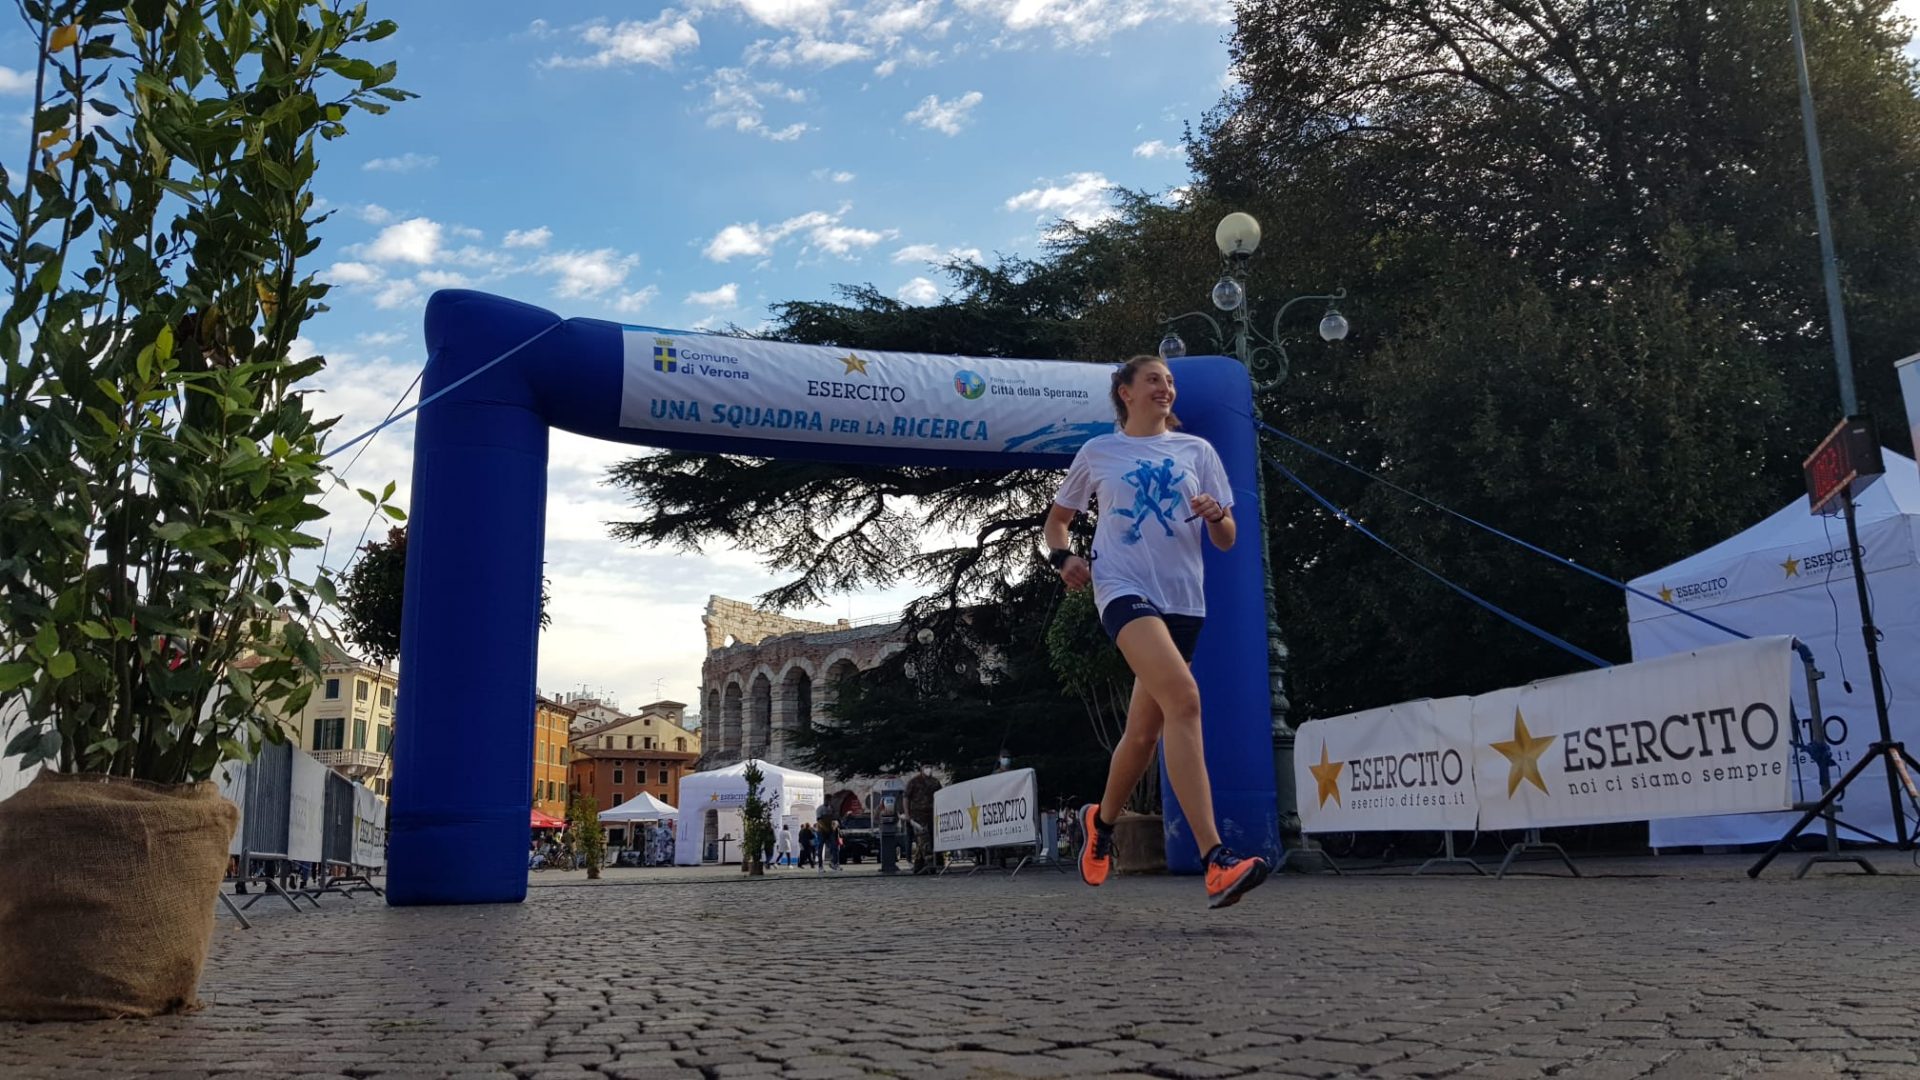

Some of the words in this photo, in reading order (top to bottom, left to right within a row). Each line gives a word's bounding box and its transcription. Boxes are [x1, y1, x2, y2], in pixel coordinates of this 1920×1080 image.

[681, 349, 739, 365] Comune
[681, 363, 695, 375] di
[700, 365, 750, 380] Verona
[807, 380, 906, 403] ESERCITO
[991, 384, 1015, 396] Città
[1017, 386, 1041, 397] della
[1043, 387, 1089, 399] Speranza
[651, 399, 701, 422] UNA
[711, 403, 823, 431] SQUADRA
[829, 418, 861, 434] PER
[865, 420, 886, 436] LA
[892, 416, 989, 441] RICERCA
[1803, 544, 1867, 570] ESERCIO
[1675, 577, 1728, 598] ESERCITO
[1563, 702, 1779, 773] ESERCITO
[1348, 748, 1463, 792] ESERCITO
[1568, 778, 1598, 795] noi
[1605, 775, 1623, 792] ci
[1631, 770, 1692, 789] siamo
[1702, 760, 1782, 782] sempre
[982, 796, 1027, 826] ESERCITO
[1351, 791, 1465, 810] esercito.difesa.it
